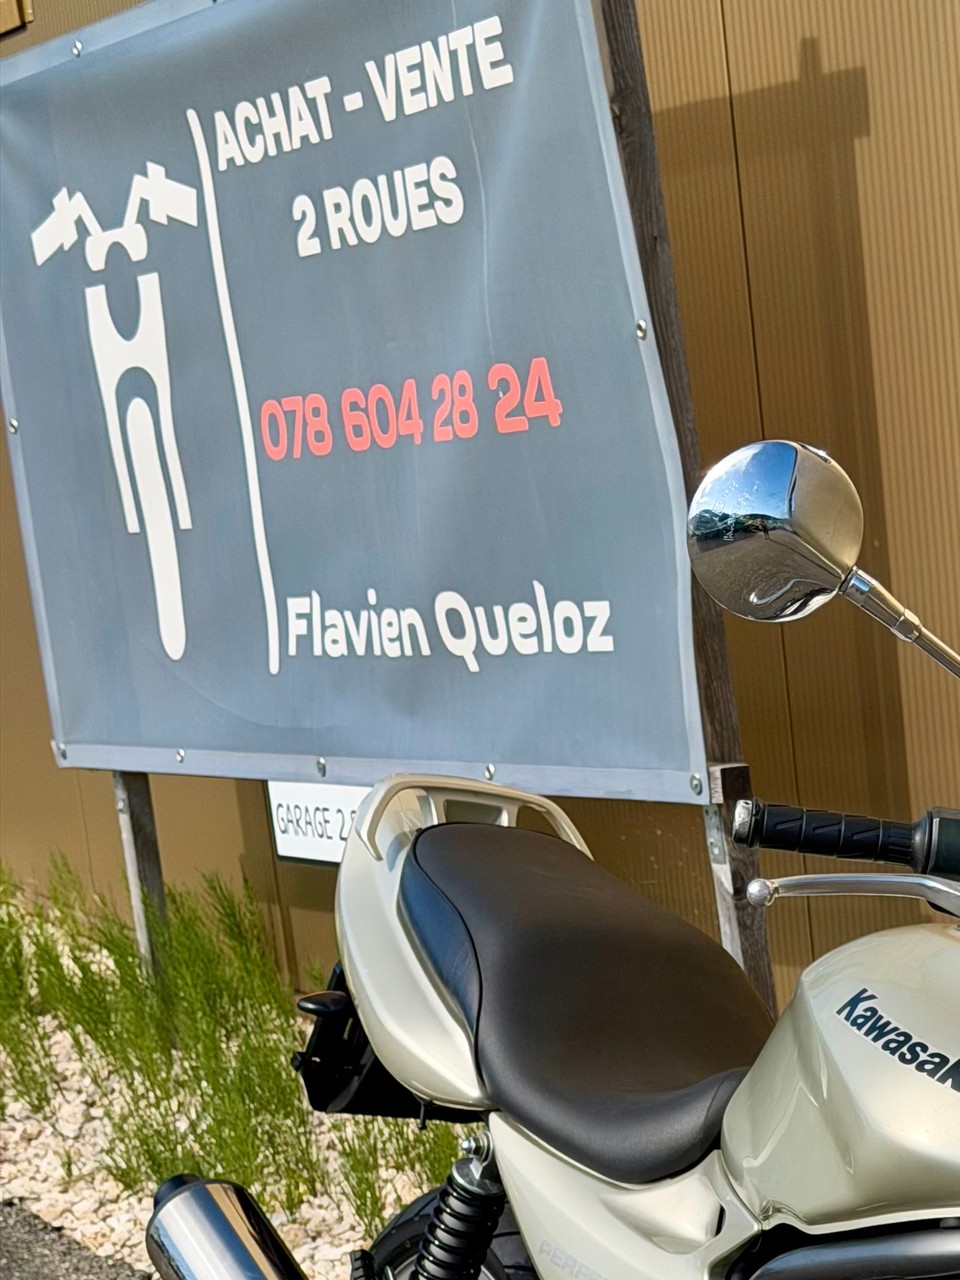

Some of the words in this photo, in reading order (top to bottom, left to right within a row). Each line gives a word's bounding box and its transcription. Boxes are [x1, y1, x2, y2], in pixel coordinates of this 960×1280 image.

[214, 76, 333, 172] ACHAT
[364, 15, 514, 123] VENTE
[292, 194, 322, 258] 2
[322, 156, 465, 250] ROUES
[260, 393, 333, 461] 078
[340, 379, 424, 452] 604
[431, 370, 480, 443] 28
[487, 357, 564, 434] 24
[285, 587, 431, 658] Flavien
[434, 579, 615, 674] Queloz
[276, 803, 333, 840] GARAGE
